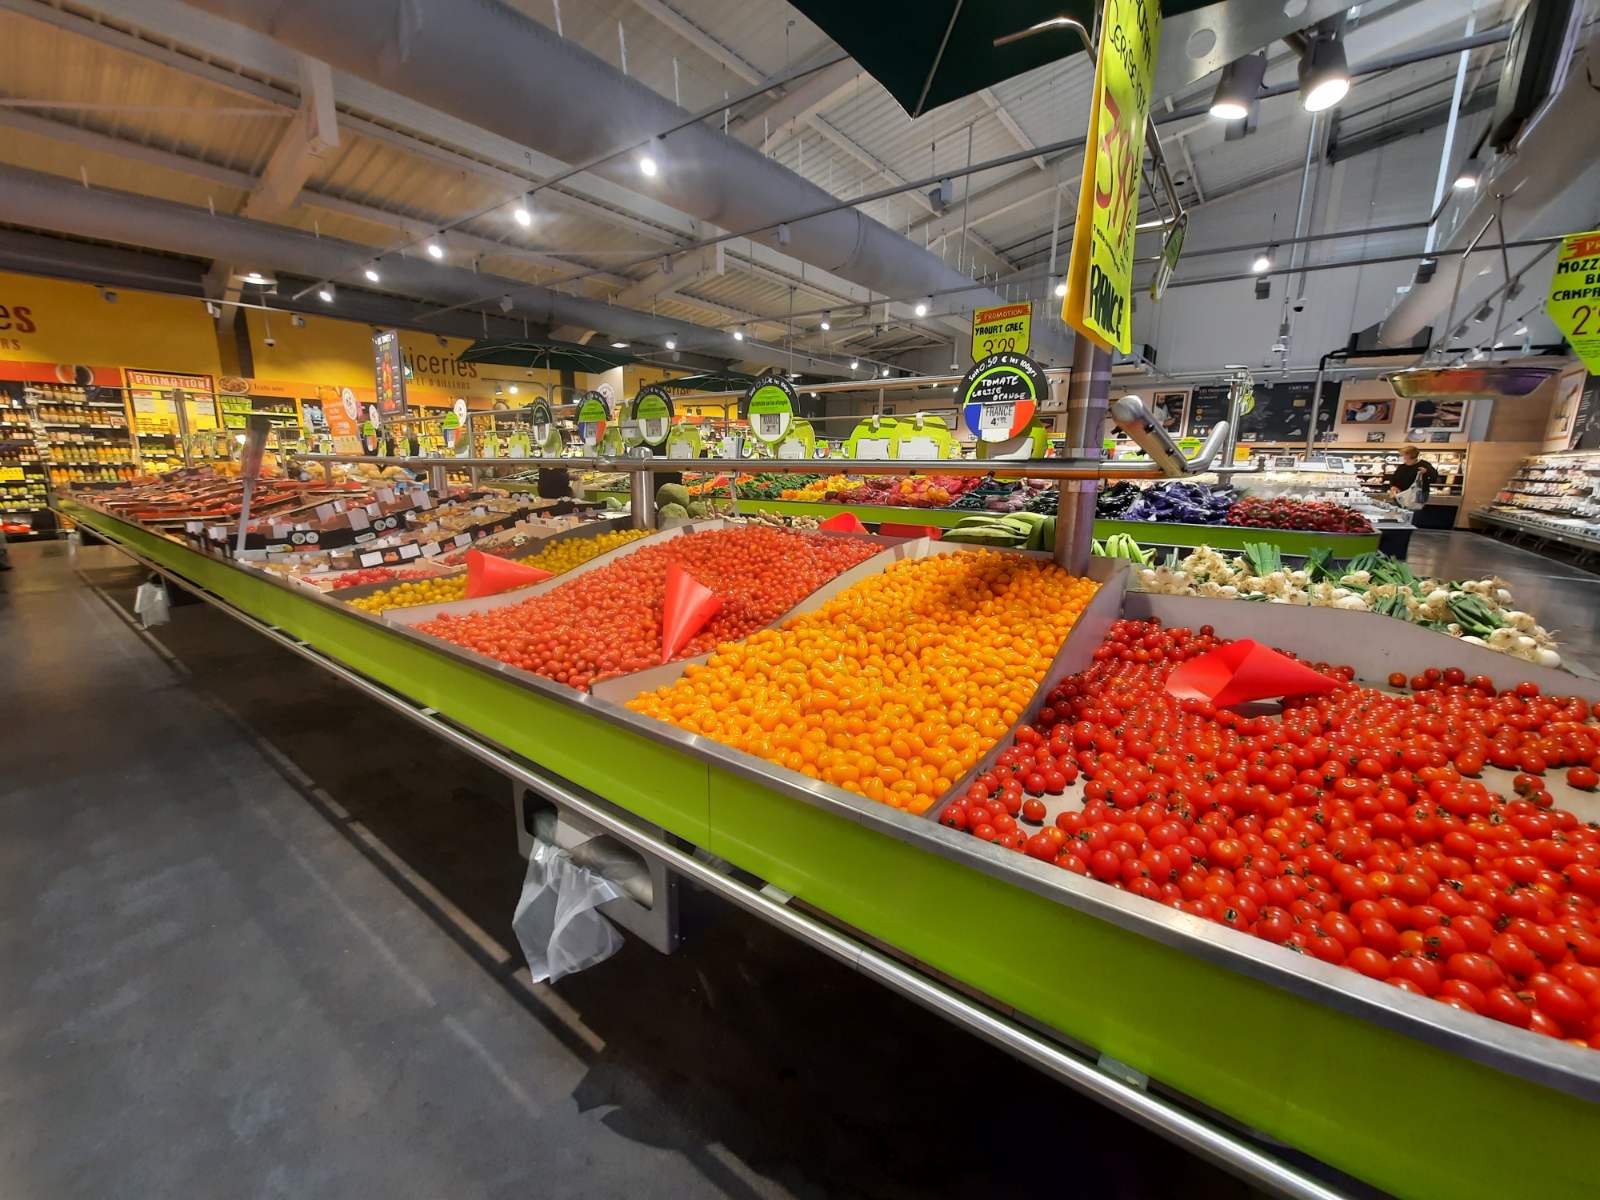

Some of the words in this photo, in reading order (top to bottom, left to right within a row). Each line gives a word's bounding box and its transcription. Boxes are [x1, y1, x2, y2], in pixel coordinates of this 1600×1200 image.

[1089, 263, 1124, 343] RANCE
[983, 308, 1023, 320] PROMOTION
[1004, 321, 1024, 333] GREC
[981, 374, 1020, 387] TOMATE
[985, 404, 1014, 417] FRANCE
